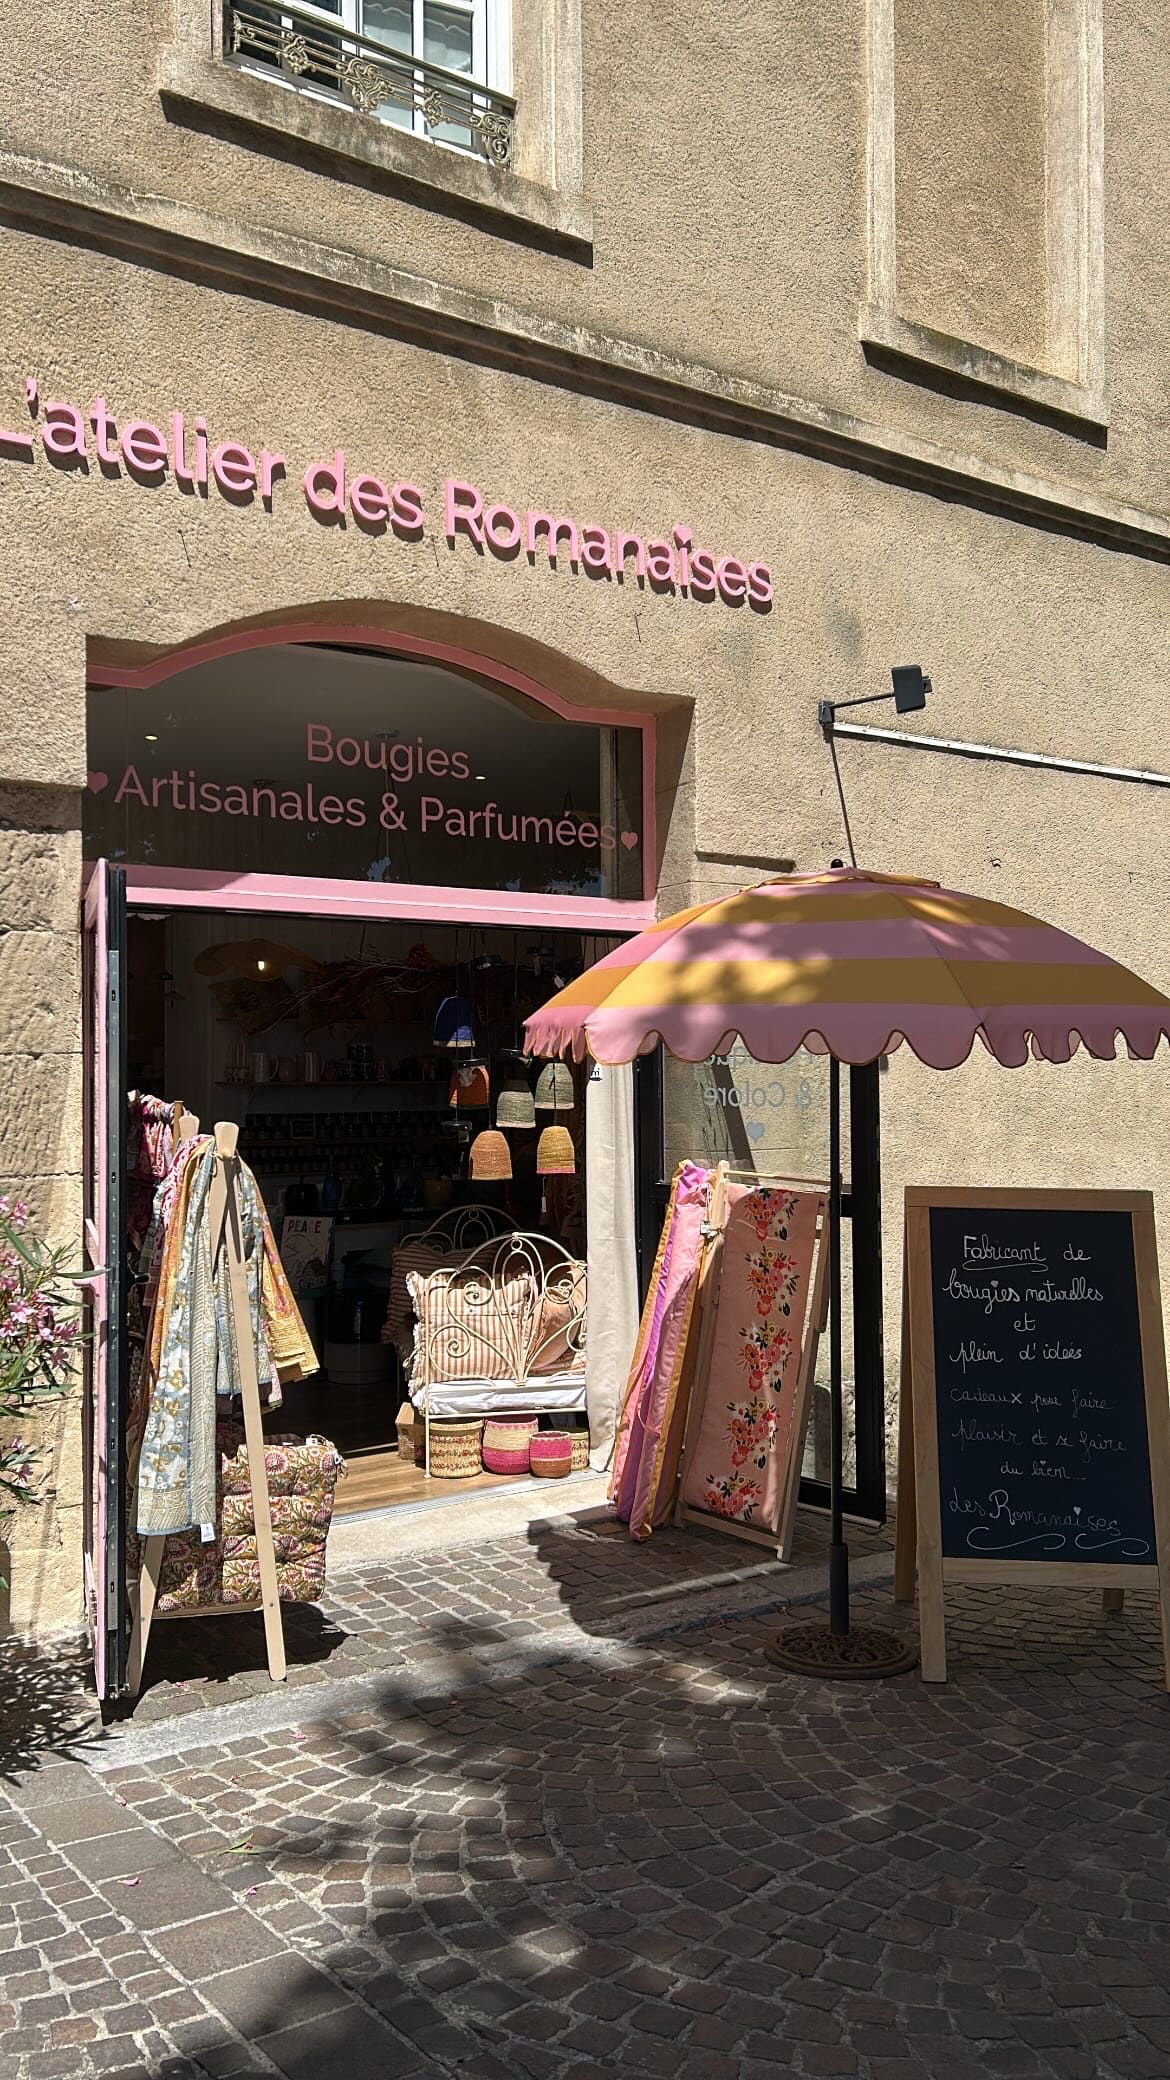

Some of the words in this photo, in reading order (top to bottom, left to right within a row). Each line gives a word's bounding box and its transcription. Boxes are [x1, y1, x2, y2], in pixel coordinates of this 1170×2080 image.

[0, 378, 286, 498] 'atelier
[304, 452, 424, 530] des
[445, 480, 773, 602] Romanaises
[306, 724, 470, 783] Bougies
[115, 766, 366, 828] Artisanales
[379, 793, 408, 831] &
[421, 796, 617, 850] Parfumées
[962, 1233, 1048, 1263] Fabricant
[1062, 1242, 1093, 1262] de
[942, 1268, 1021, 1315] bougies
[1024, 1276, 1104, 1303] naturelles
[1013, 1311, 1037, 1333] et
[949, 1339, 1004, 1374] plein
[950, 1387, 1024, 1406] cadeaux
[1030, 1391, 1063, 1413] pour
[1071, 1388, 1113, 1419] faire
[951, 1416, 1023, 1452] plaisir
[1031, 1427, 1049, 1446] et
[1079, 1429, 1127, 1464] faire
[1000, 1459, 1024, 1476] du
[988, 1488, 1122, 1537] Romanaises
